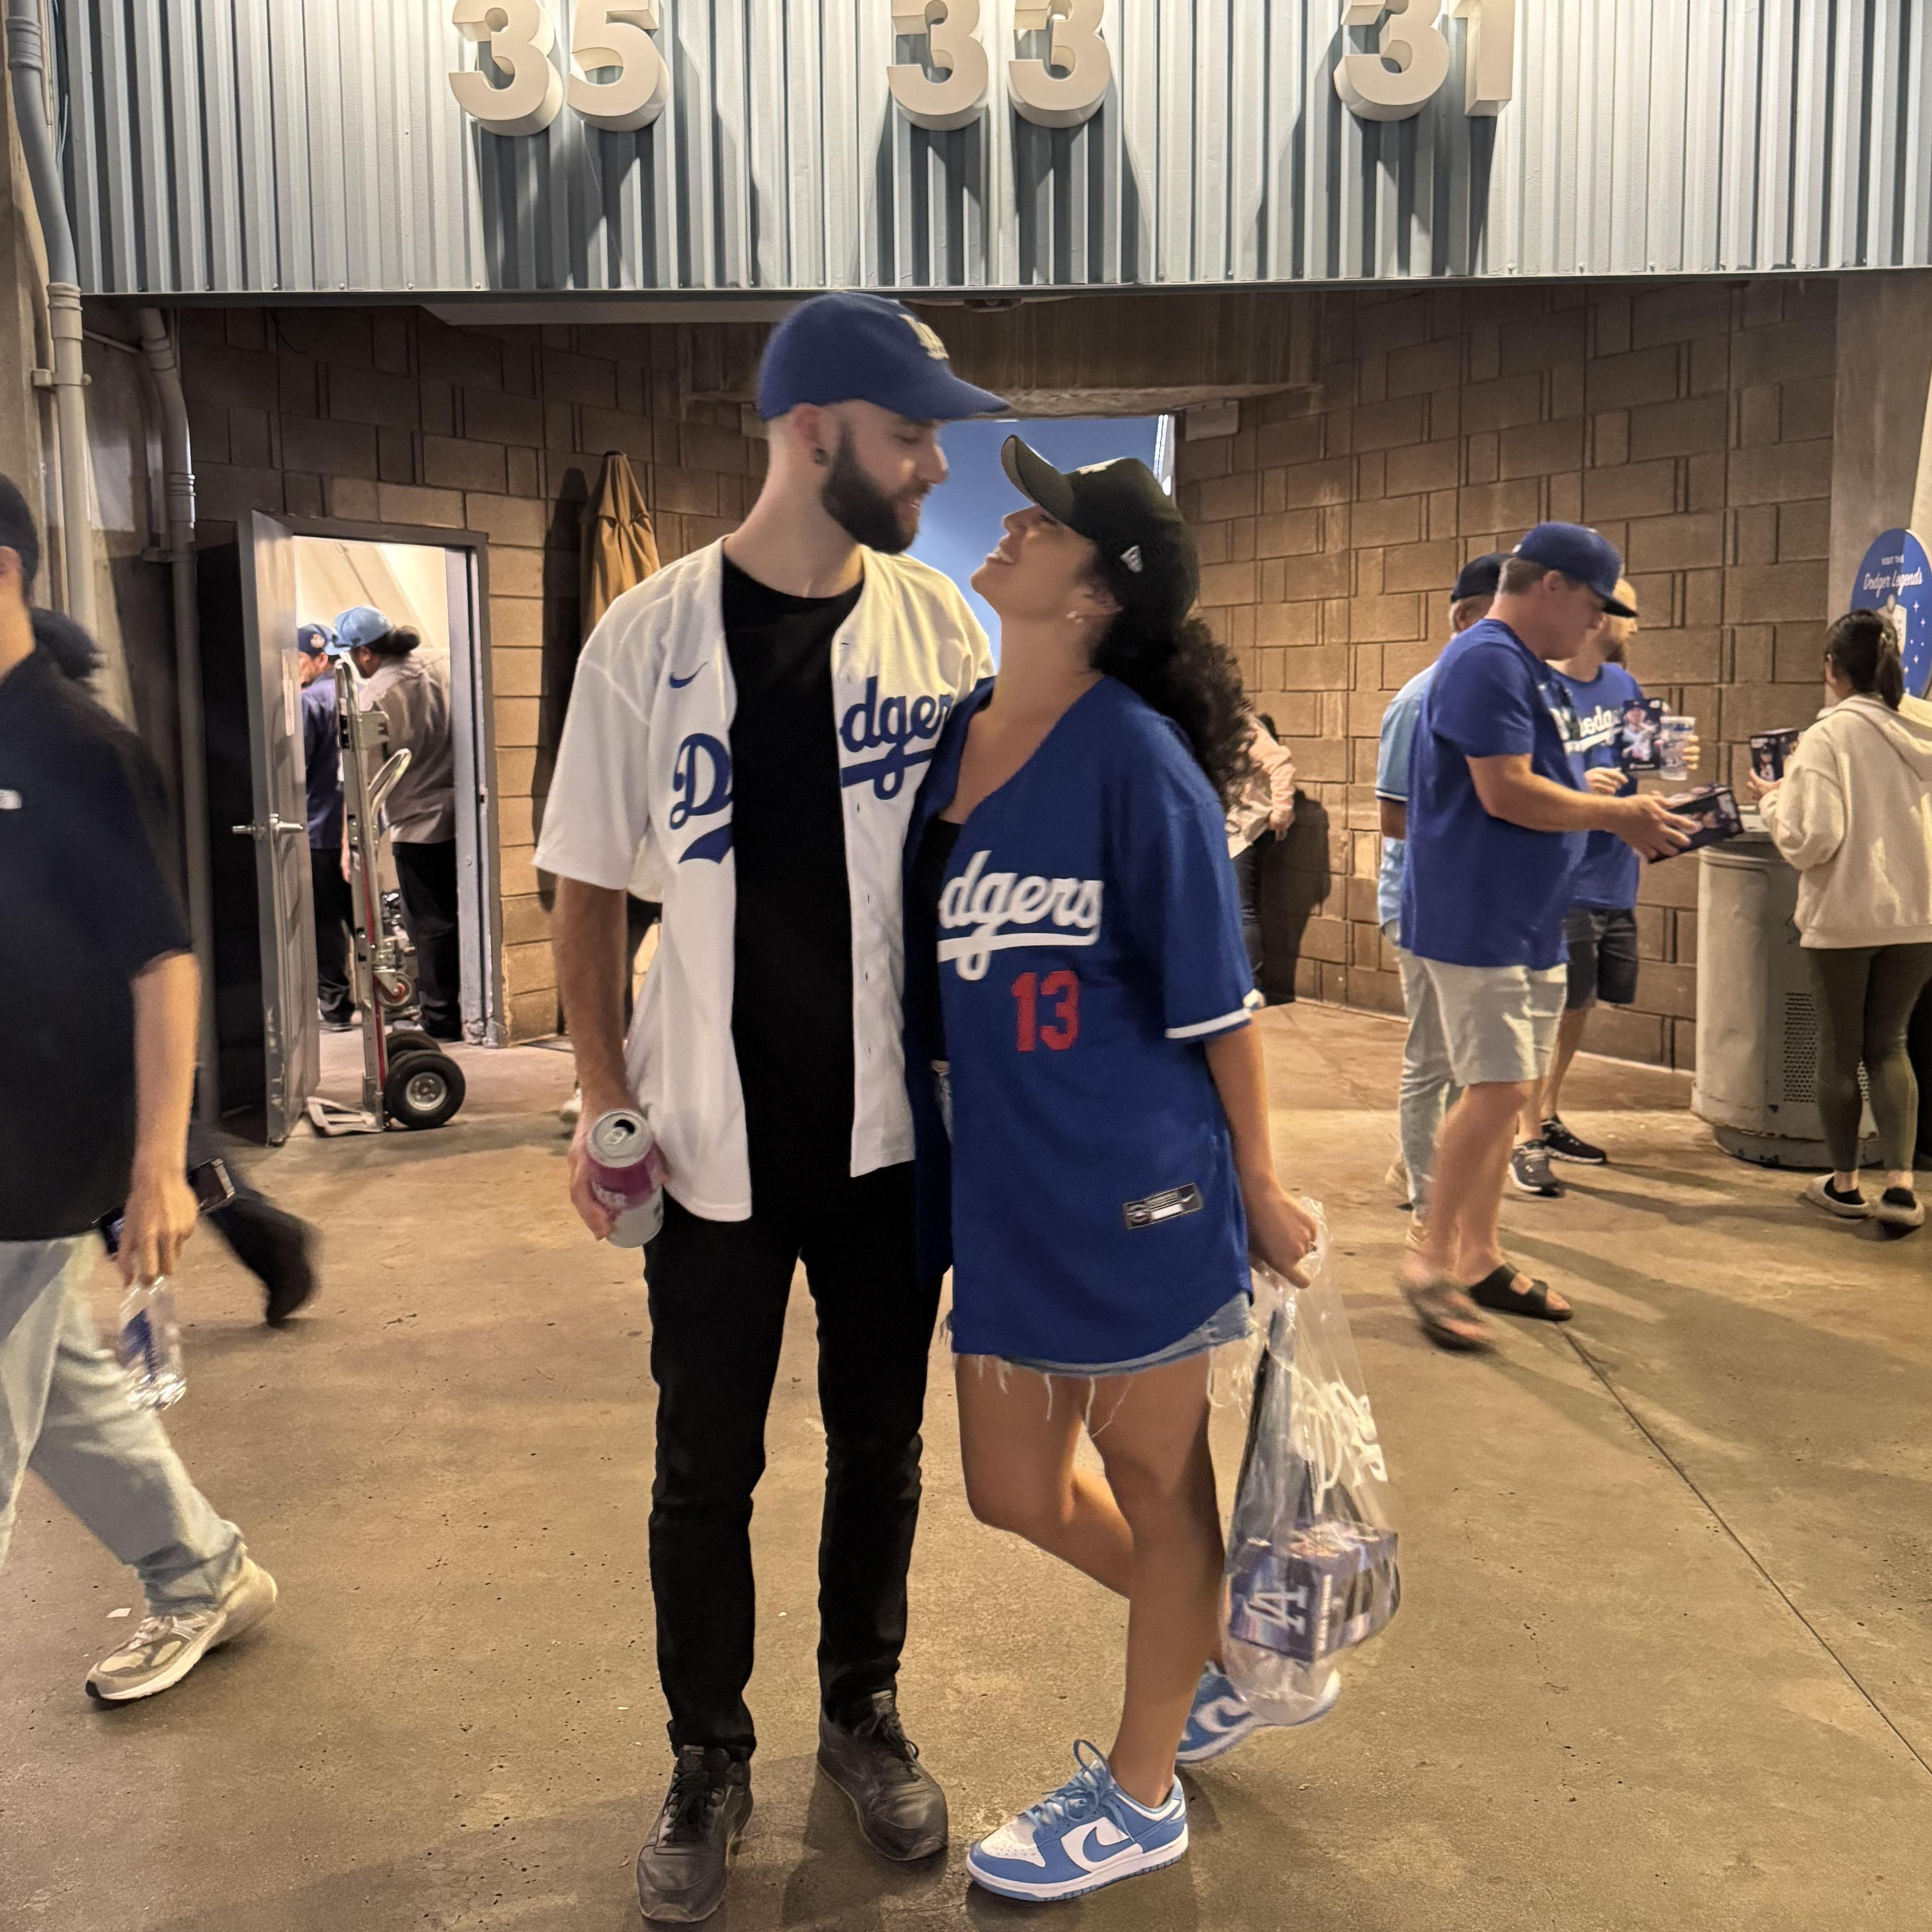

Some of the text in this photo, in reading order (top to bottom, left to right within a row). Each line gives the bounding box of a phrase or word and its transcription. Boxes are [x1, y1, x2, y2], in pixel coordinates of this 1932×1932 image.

[449, 0, 668, 136] 35
[887, 0, 1112, 129] 33
[1334, 0, 1515, 121] 31
[1863, 566, 1922, 598] Dodger Legends
[1012, 970, 1080, 1051] 13
